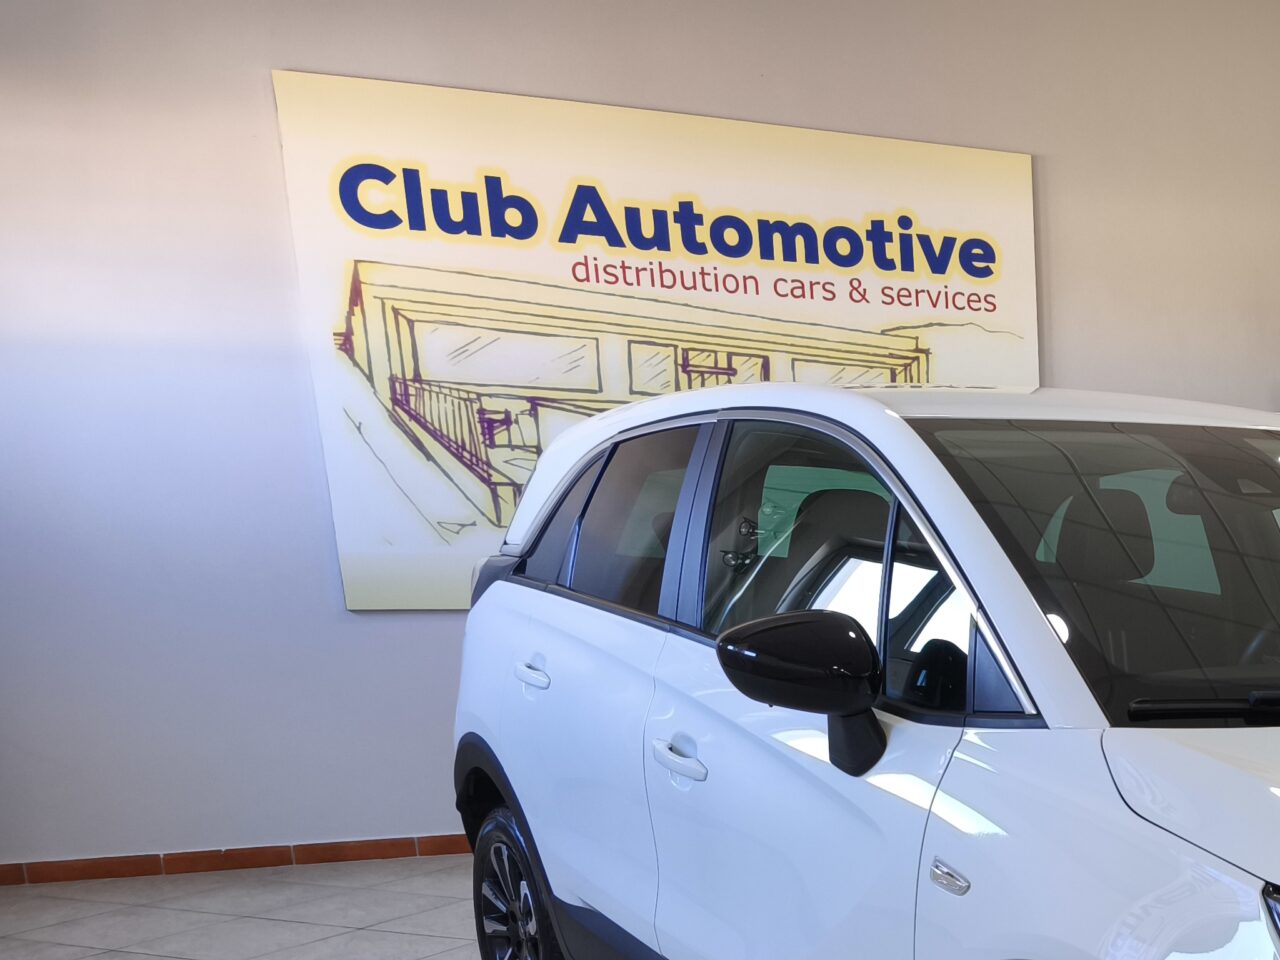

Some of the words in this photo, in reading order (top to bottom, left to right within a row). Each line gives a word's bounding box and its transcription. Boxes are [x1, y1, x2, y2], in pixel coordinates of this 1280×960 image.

[338, 163, 539, 241] Club
[557, 184, 997, 279] Automotive
[571, 255, 760, 296] distribution
[772, 276, 837, 302] cars
[848, 277, 871, 304] &
[880, 284, 998, 313] services
